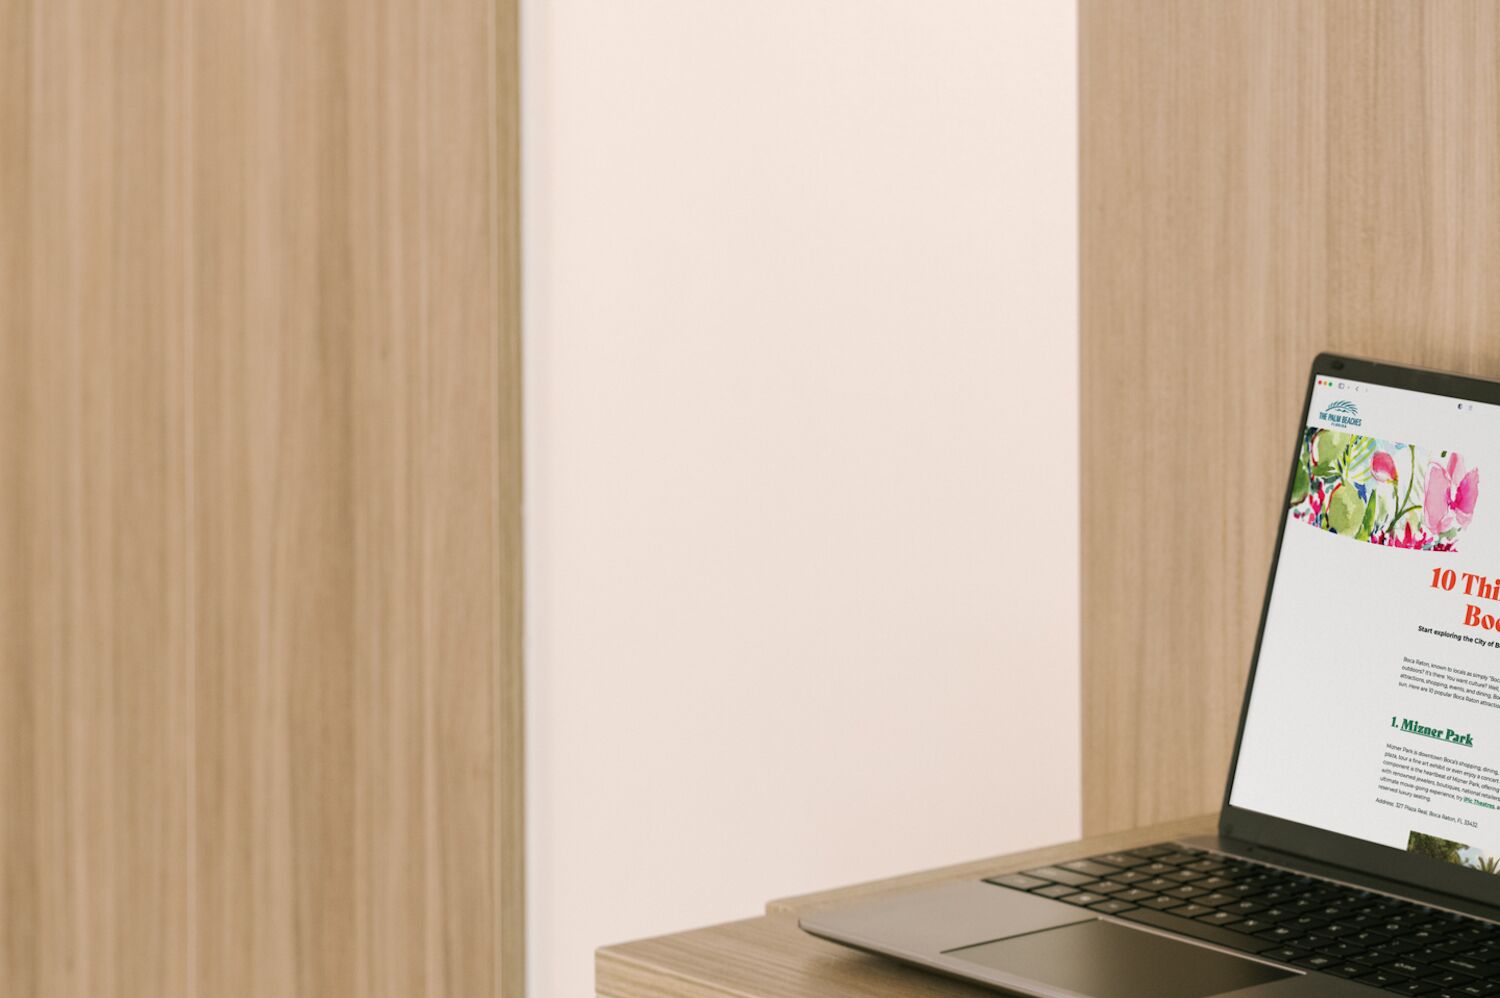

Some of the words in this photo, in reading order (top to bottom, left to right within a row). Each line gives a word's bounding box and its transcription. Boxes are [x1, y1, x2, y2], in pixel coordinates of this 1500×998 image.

[1319, 411, 1329, 421] THE
[1328, 413, 1342, 423] PALM
[1341, 415, 1362, 427] BEACHES
[1431, 567, 1457, 592] 10
[1418, 625, 1433, 634] Start
[1433, 630, 1462, 642] exploring
[1462, 635, 1474, 643] the
[1474, 637, 1487, 647] City
[1391, 716, 1399, 728] 1.
[1400, 718, 1444, 741] Mizner
[1444, 728, 1473, 748] Park
